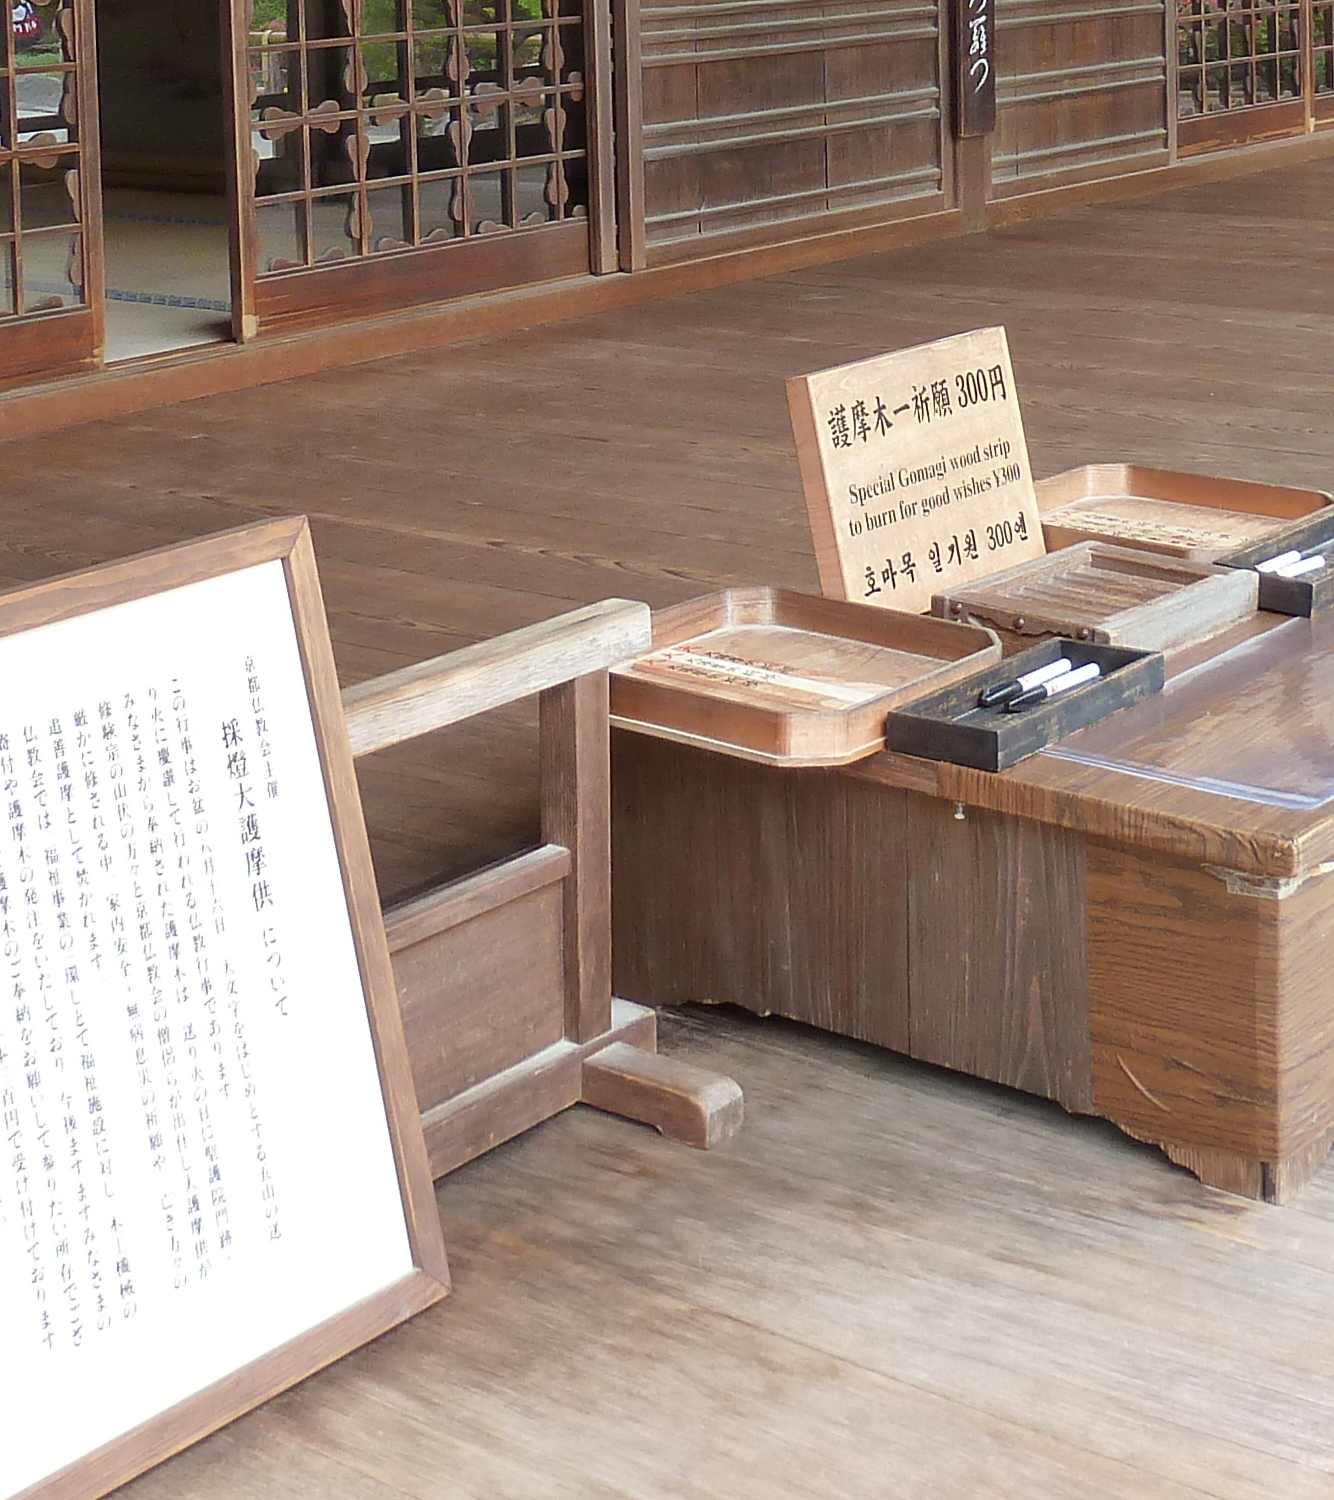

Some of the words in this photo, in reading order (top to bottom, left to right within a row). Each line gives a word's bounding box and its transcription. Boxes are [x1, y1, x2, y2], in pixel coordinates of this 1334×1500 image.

[828, 379, 953, 450] 護摩木一祈願
[955, 364, 1008, 412] 300円
[848, 471, 896, 510] Special
[898, 456, 947, 489] Gomagi
[950, 445, 981, 472] wood
[983, 437, 1011, 466] strip
[848, 517, 863, 538] to
[865, 505, 897, 533] burn
[899, 499, 918, 524] for
[921, 486, 950, 517] good
[953, 473, 992, 501] wishes
[993, 462, 1021, 490] ¥300
[864, 550, 917, 598] 호마목
[987, 511, 1030, 552] 300엔
[244, 655, 278, 798] 京都仏教会主催
[221, 717, 273, 911] 採燈大護摩供
[262, 926, 288, 1016] について
